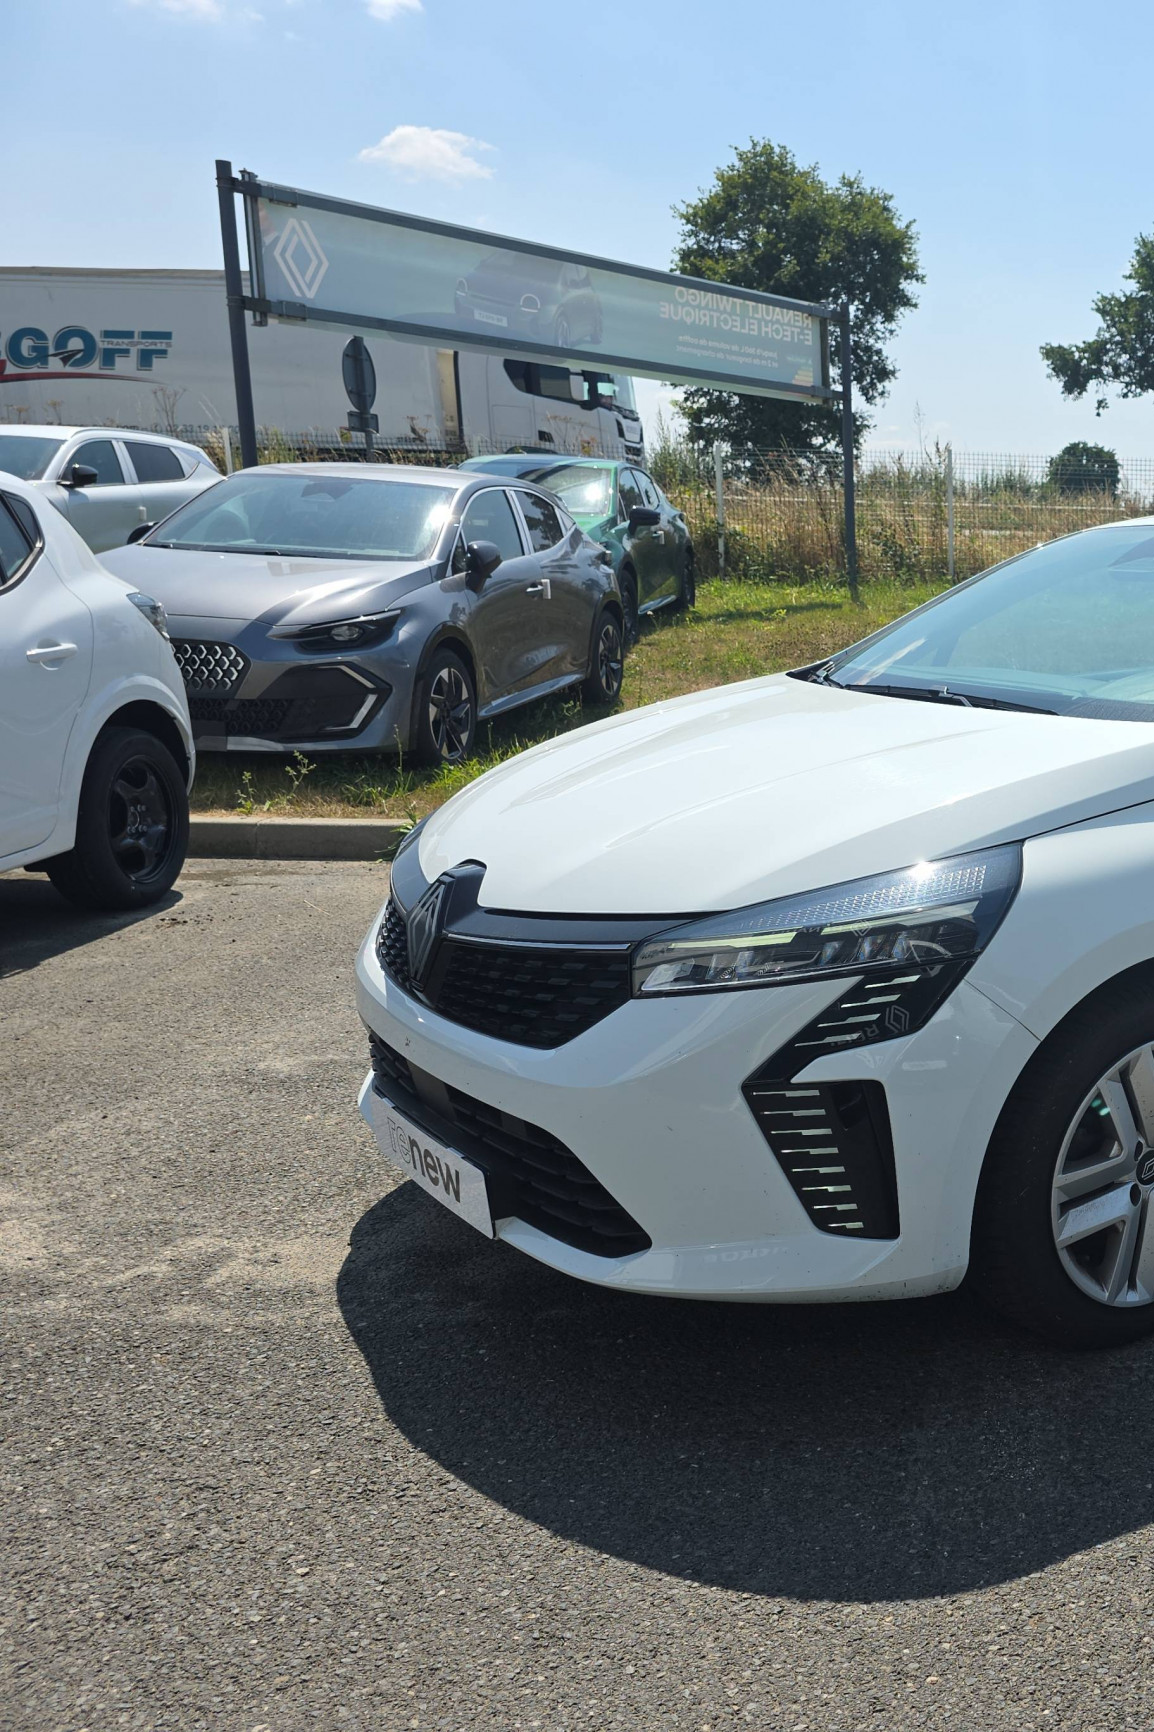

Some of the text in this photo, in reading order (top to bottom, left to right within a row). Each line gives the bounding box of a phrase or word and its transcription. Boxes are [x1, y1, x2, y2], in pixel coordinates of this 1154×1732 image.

[0, 325, 173, 371] GOFF
[101, 340, 173, 348] TRANSPORTS
[387, 1116, 461, 1203] renew
